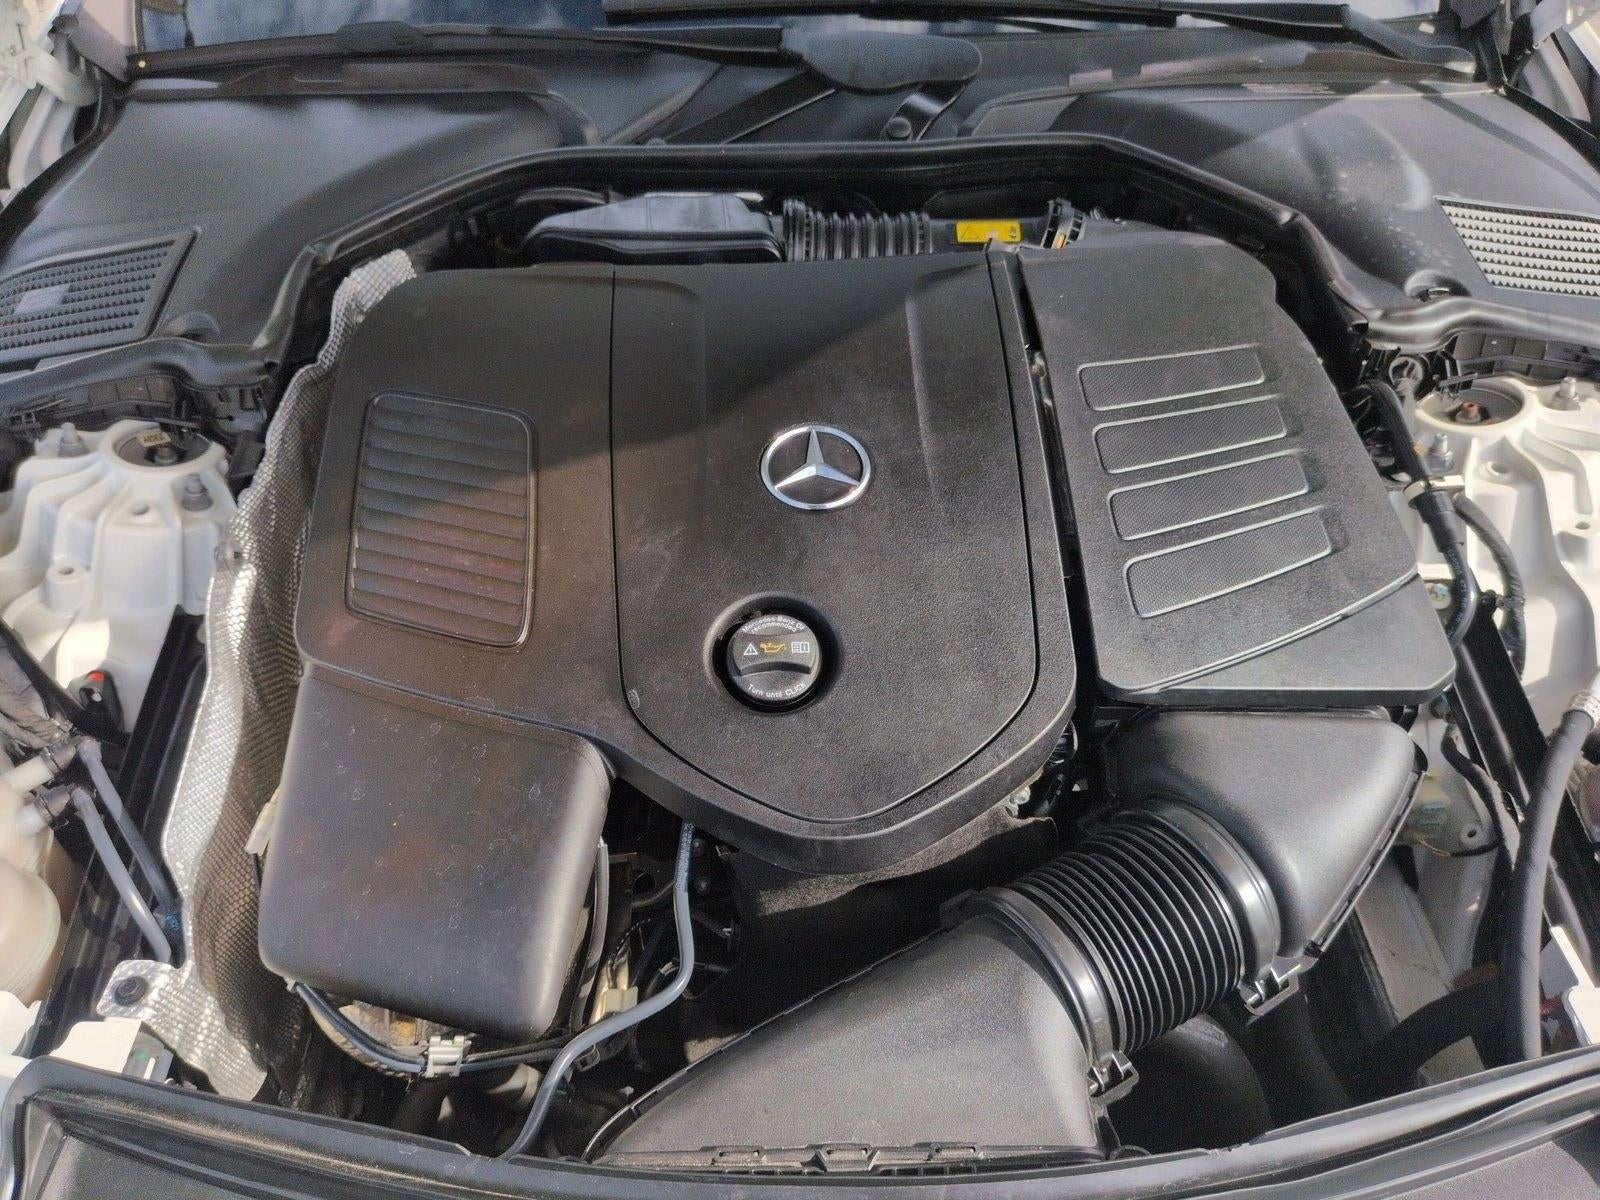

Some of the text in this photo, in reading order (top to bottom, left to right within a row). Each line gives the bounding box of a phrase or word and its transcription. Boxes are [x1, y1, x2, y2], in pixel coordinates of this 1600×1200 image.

[748, 681, 807, 698] Turn until CLICK
